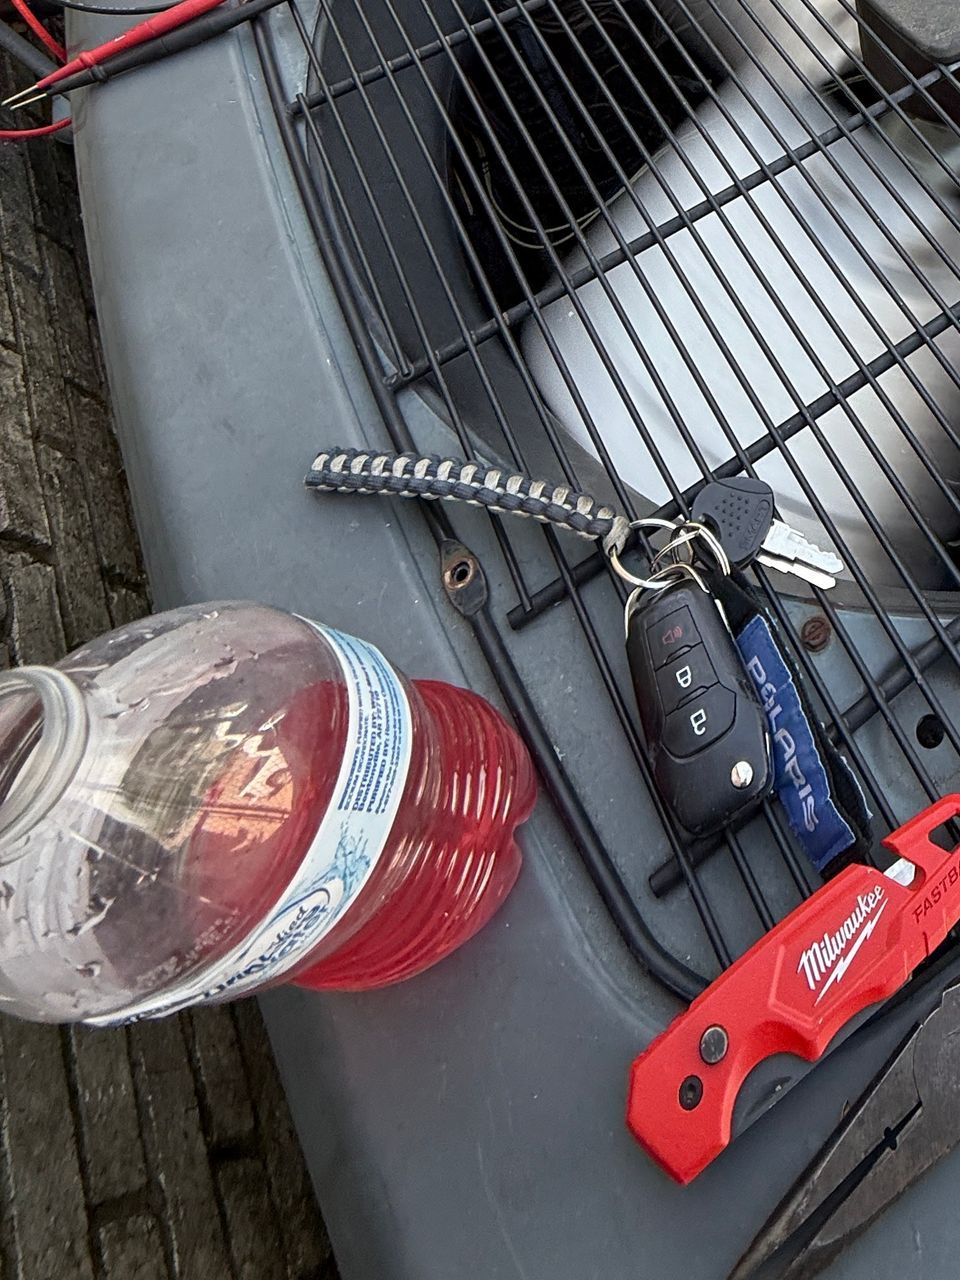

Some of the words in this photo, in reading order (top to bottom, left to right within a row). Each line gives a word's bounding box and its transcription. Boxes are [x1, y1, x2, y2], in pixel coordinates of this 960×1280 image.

[352, 731, 377, 810] DISTRIBUTED
[358, 742, 382, 811] Bentonville,
[366, 759, 386, 812] PURIFIED
[797, 884, 885, 990] Milwaukee
